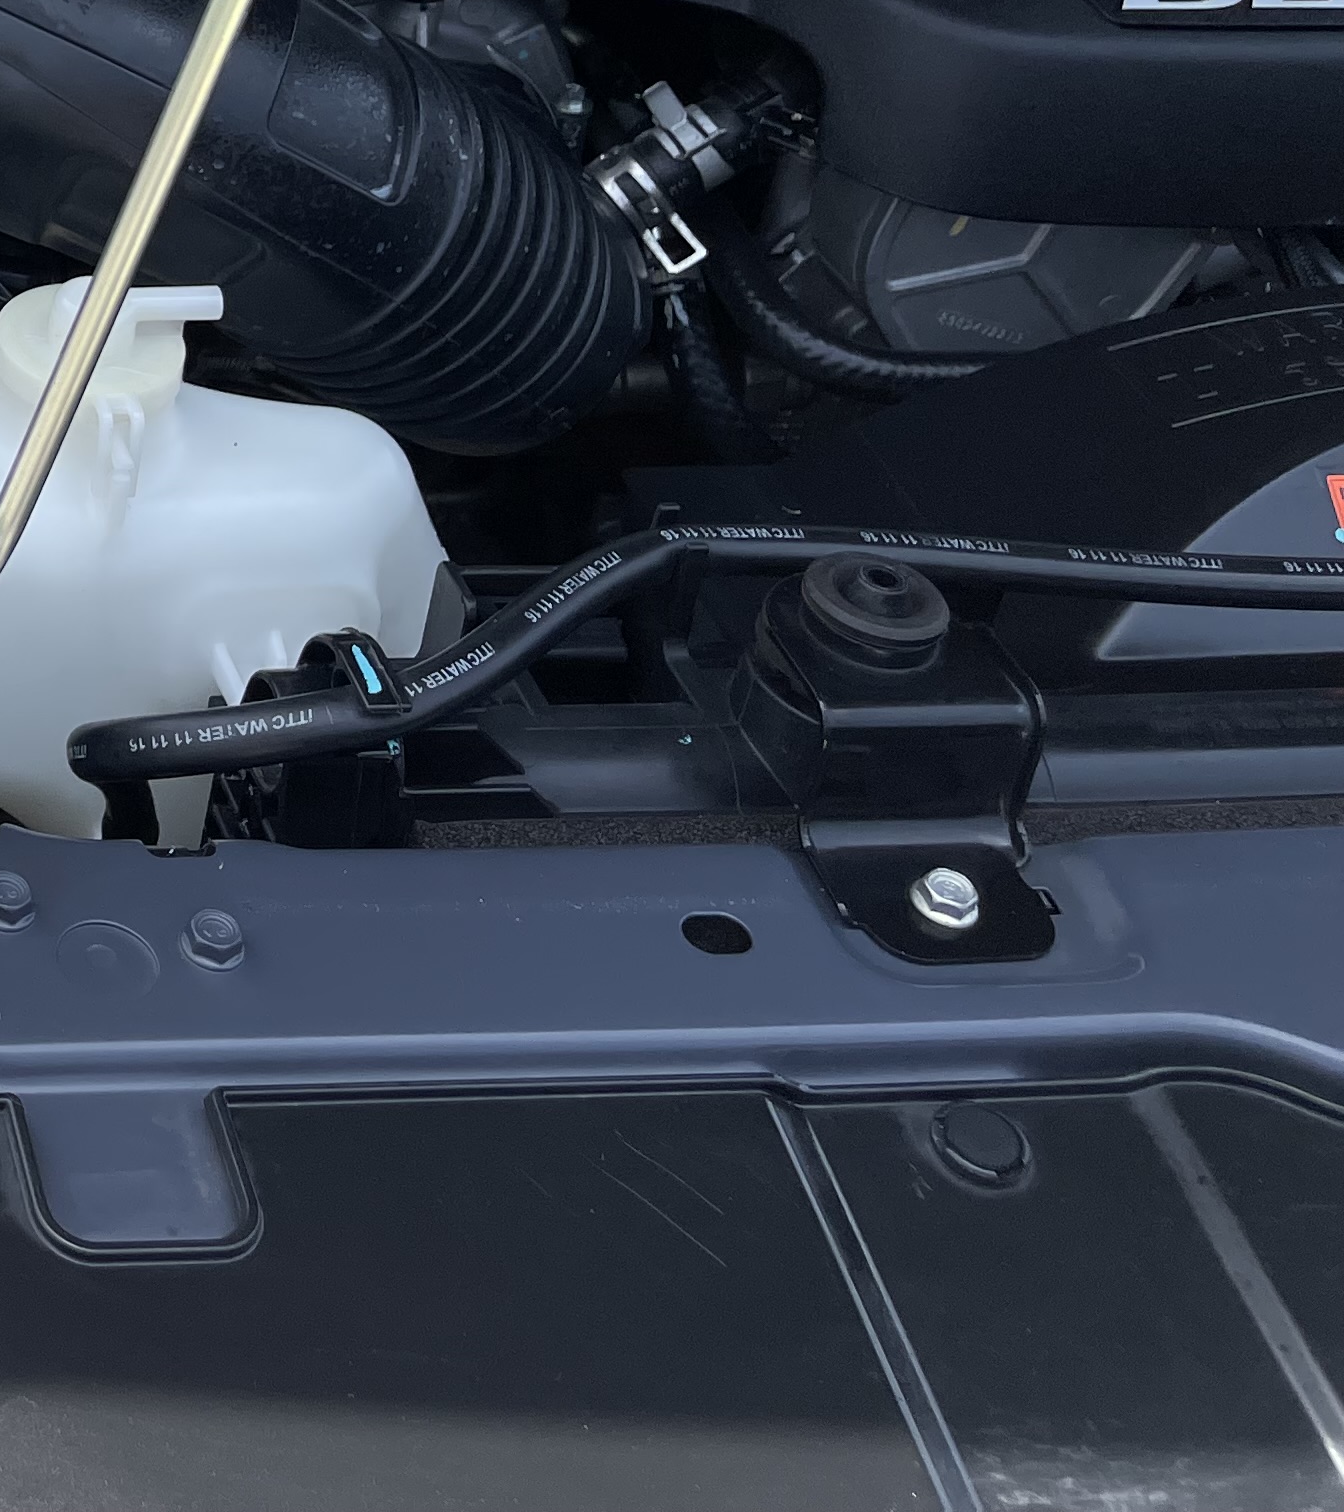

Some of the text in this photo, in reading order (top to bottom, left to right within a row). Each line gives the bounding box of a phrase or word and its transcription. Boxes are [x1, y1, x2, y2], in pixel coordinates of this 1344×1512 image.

[719, 527, 771, 540] WATER
[1130, 553, 1191, 568] WATER
[557, 564, 602, 595] WATER
[547, 587, 565, 604] 11
[535, 598, 553, 614] 11
[524, 607, 542, 623] 16
[420, 658, 474, 689] WATER
[404, 682, 423, 697] 11
[174, 730, 193, 746] 11
[197, 717, 269, 743] WATER
[151, 734, 169, 750] 11
